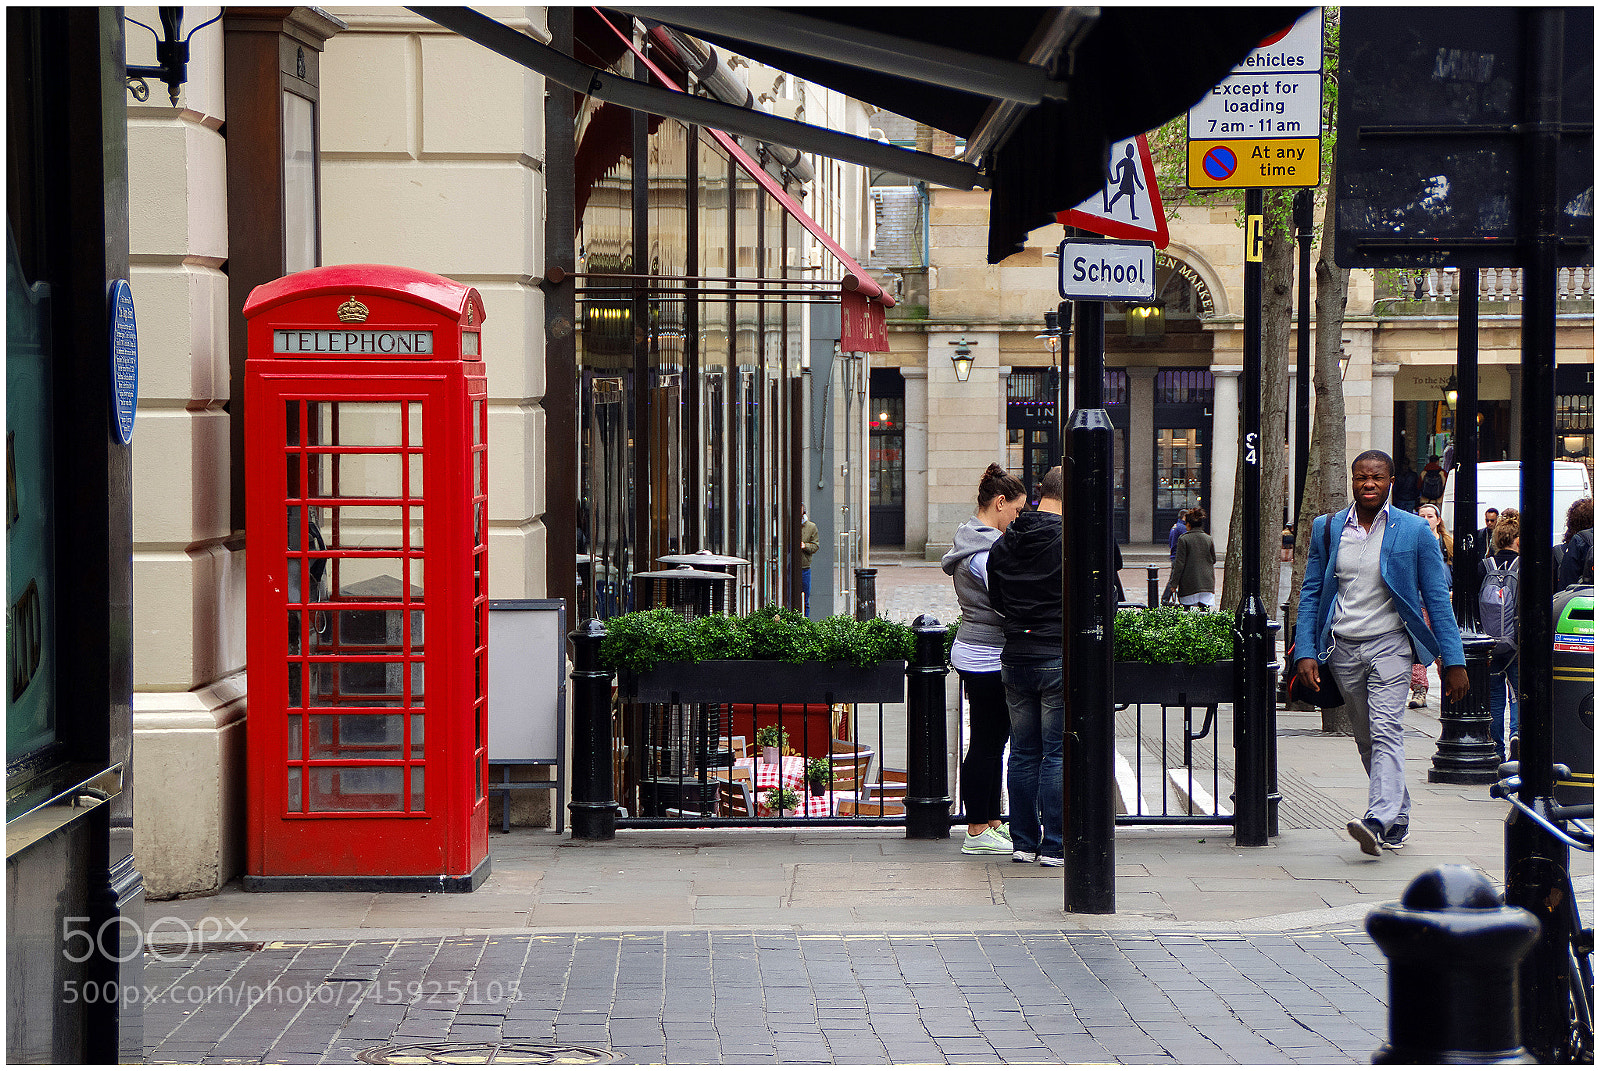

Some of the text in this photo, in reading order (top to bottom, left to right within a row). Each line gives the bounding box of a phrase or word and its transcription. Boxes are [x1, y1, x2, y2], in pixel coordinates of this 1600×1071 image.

[1212, 80, 1299, 97] Except for
[1224, 99, 1285, 114] loading
[1251, 145, 1305, 161] At any
[1260, 163, 1296, 176] time
[1072, 256, 1145, 284] School
[1178, 264, 1214, 317] MARKET
[279, 332, 428, 353] TELEPHONE
[1425, 376, 1438, 384] the
